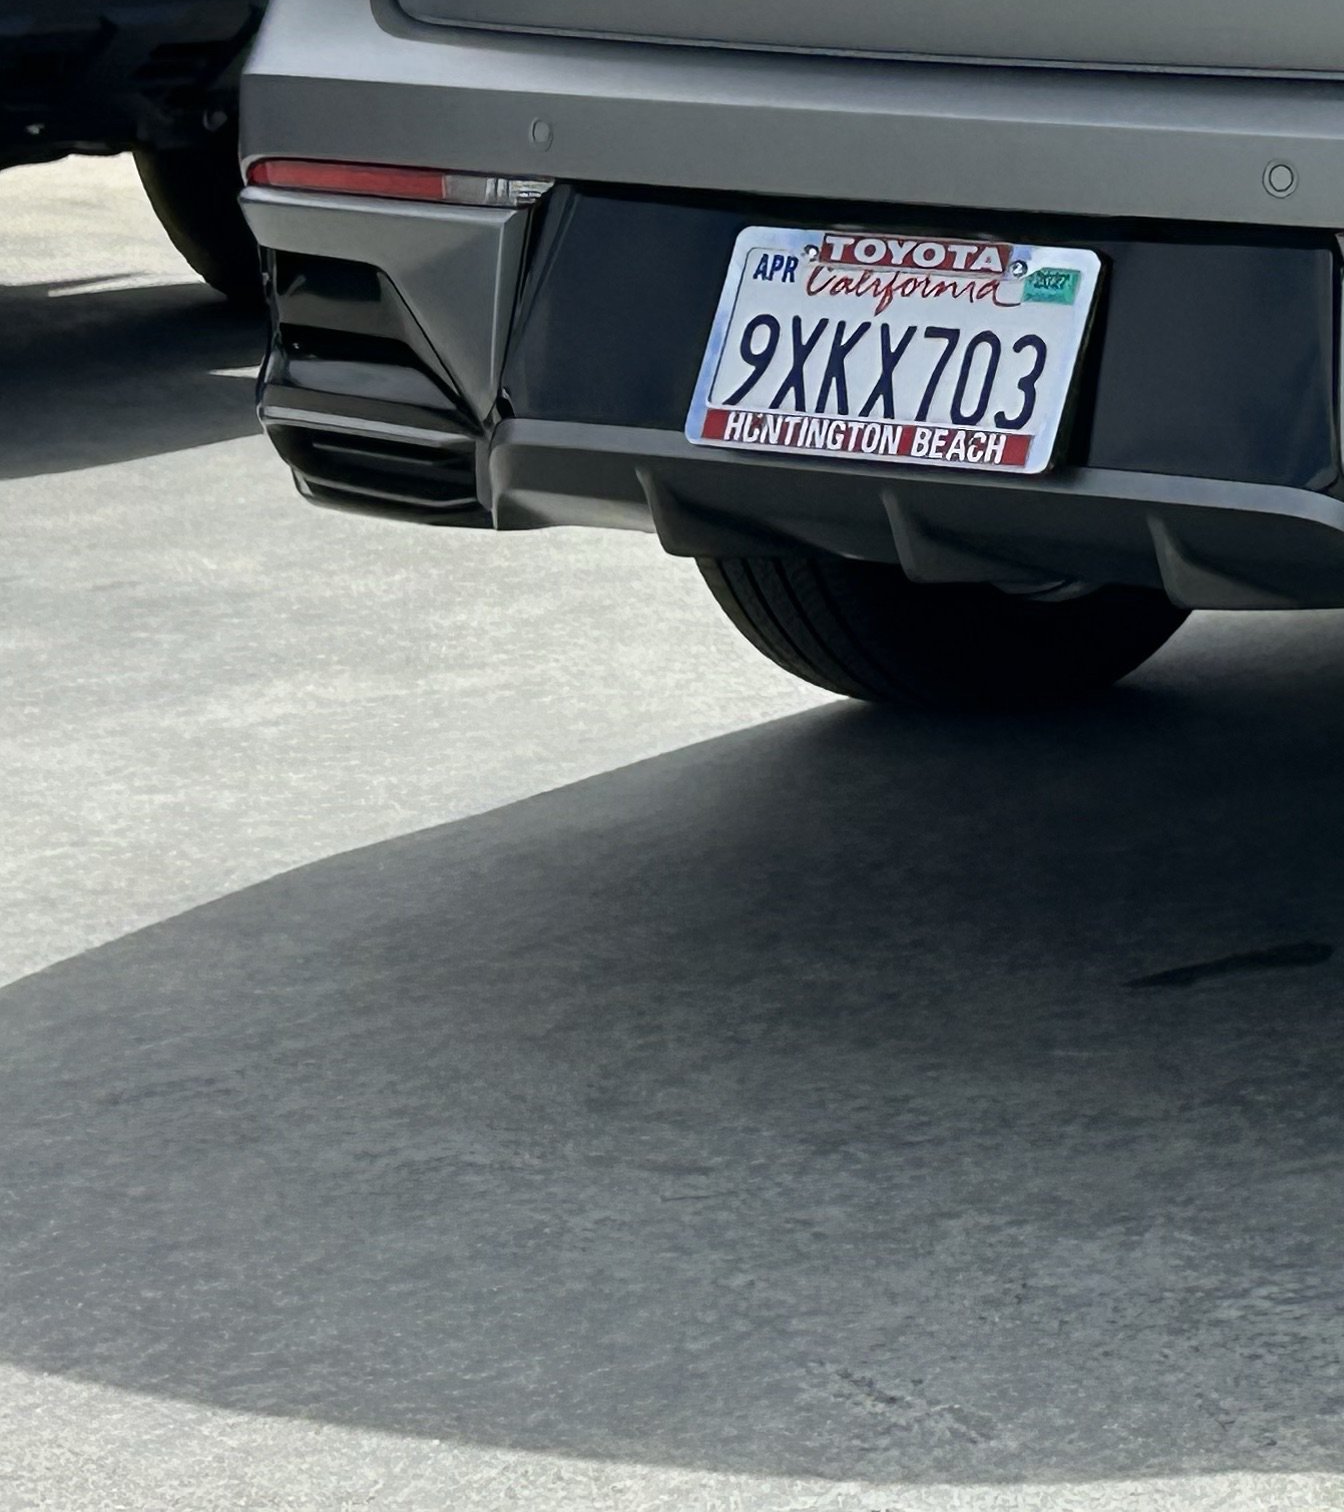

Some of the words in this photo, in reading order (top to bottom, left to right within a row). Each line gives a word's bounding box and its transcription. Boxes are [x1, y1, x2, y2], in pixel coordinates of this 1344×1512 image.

[752, 253, 798, 284] APR
[824, 236, 1004, 272] TOYOTA
[806, 265, 1021, 316] California
[723, 314, 1048, 430] 9XKX703
[724, 411, 902, 456] HUNTINGTON
[911, 426, 1006, 466] BEACH
